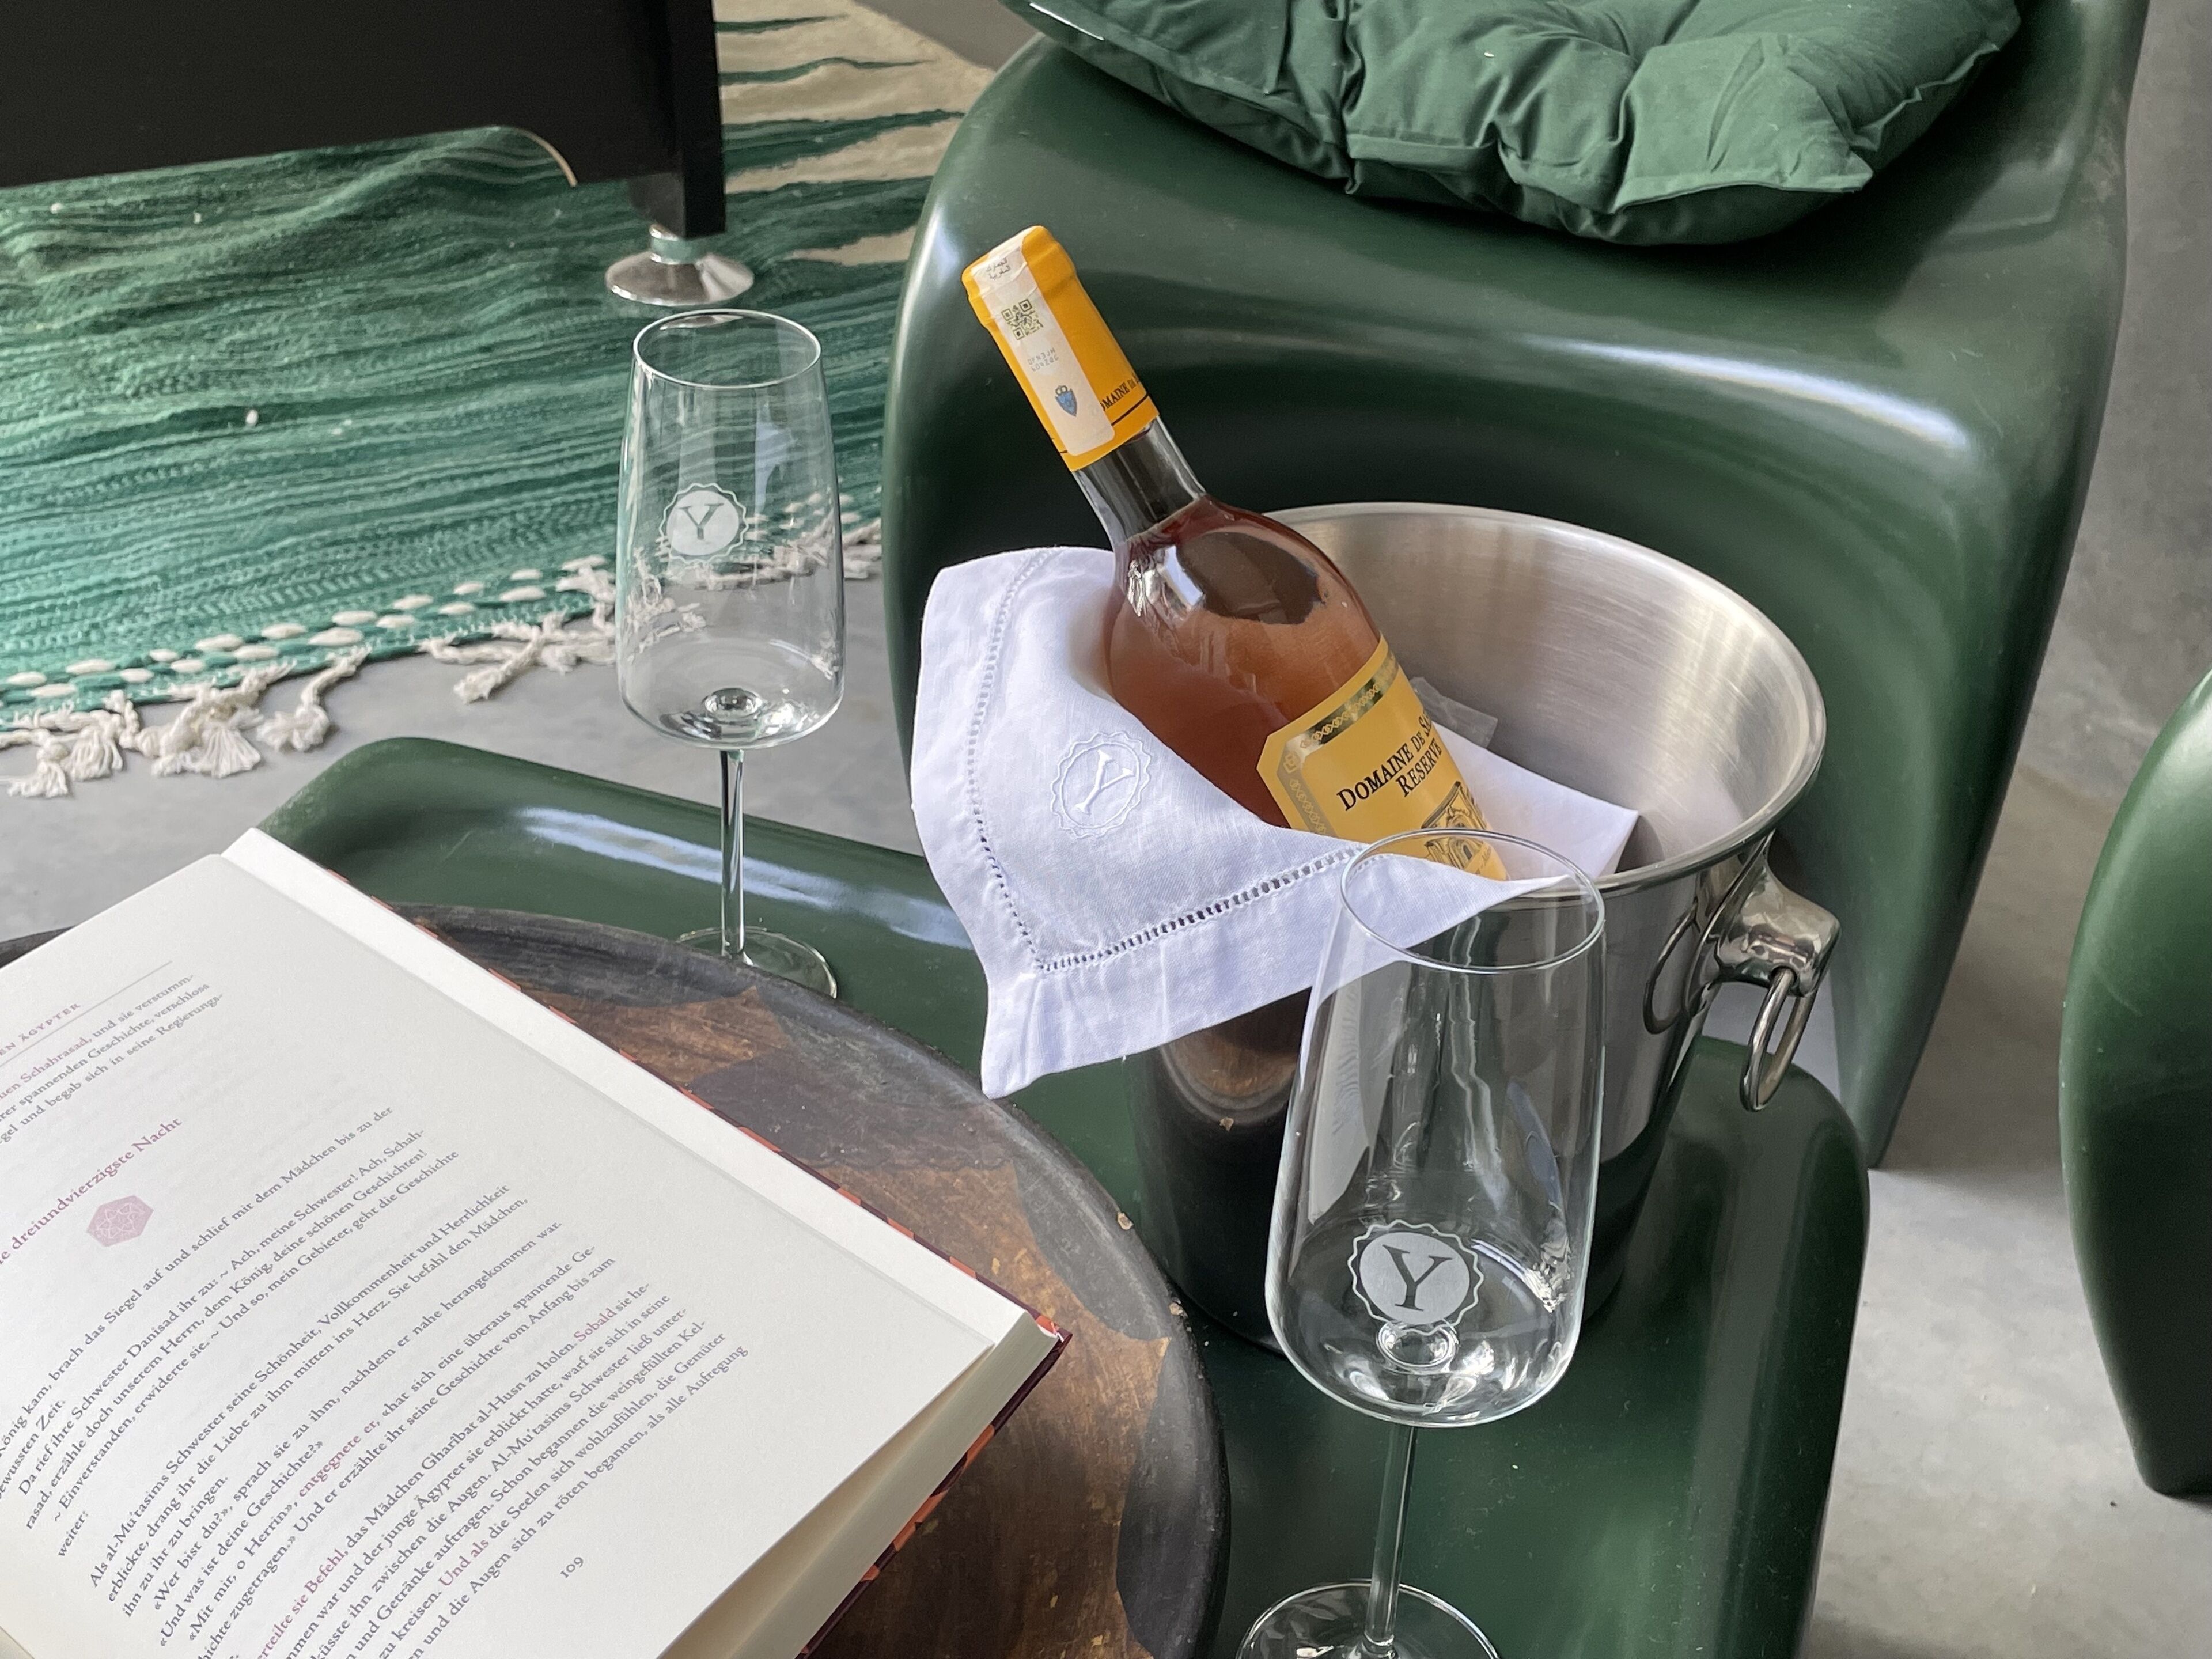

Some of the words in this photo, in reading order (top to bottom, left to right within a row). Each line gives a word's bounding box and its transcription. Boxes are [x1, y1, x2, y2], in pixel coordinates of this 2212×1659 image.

[677, 502, 724, 543] Y
[1075, 750, 1135, 814] Y
[1336, 744, 1413, 811] DOMAINE
[1414, 732, 1426, 752] DE
[1396, 738, 1442, 797] RESERVE
[12, 1152, 134, 1249] dreiundvierzigste
[131, 1119, 182, 1152] Nacht
[18, 1474, 37, 1495] Da
[36, 1444, 53, 1472] rief
[51, 1421, 74, 1448] ihre
[71, 1358, 128, 1420] Schwester
[127, 1310, 180, 1358] Danisad
[177, 1296, 197, 1312] ihr
[198, 1279, 218, 1296] zu:
[231, 1249, 260, 1270] Ach,
[259, 1220, 296, 1248] meine
[294, 1174, 358, 1221] Schwester!
[359, 1158, 386, 1176] Ach,
[22, 1385, 52, 1414] kam,
[48, 1348, 84, 1381] brach
[85, 1325, 105, 1344] das
[104, 1289, 142, 1324] Siegel
[143, 1268, 164, 1290] auf
[165, 1249, 191, 1271] und
[192, 1217, 230, 1251] schlief
[232, 1203, 254, 1220] mit
[255, 1184, 283, 1203] dem
[280, 1146, 337, 1184] Mädchen
[334, 1133, 355, 1145] bis
[357, 1122, 372, 1132] zu
[374, 1107, 392, 1121] der
[59, 1416, 135, 1509] Einverstanden,
[135, 1359, 189, 1414] erwiderte
[190, 1342, 210, 1359] sie.
[218, 1304, 250, 1328] Und
[250, 1293, 268, 1306] so,
[268, 1267, 300, 1291] mein
[298, 1228, 353, 1266] Gebieter,
[353, 1207, 378, 1230] geht
[378, 1195, 397, 1208] die
[396, 1152, 459, 1194] Geschichte
[1382, 1244, 1452, 1312] Y
[26, 1490, 52, 1529] rasad,
[51, 1440, 86, 1487] erzähle
[86, 1407, 113, 1438] doch
[113, 1357, 163, 1405] unserem
[160, 1320, 204, 1354] Herrn,
[204, 1295, 232, 1317] dem
[229, 1263, 273, 1294] König,
[274, 1237, 306, 1262] deine
[306, 1203, 354, 1237] schönen
[353, 1149, 427, 1200] Geschichten!
[109, 1541, 149, 1601] erblickte,
[147, 1498, 181, 1537] drang
[176, 1476, 196, 1497] ihr
[197, 1455, 216, 1474] die
[213, 1420, 249, 1453] Liebe
[250, 1404, 267, 1419] zu
[265, 1380, 294, 1402] ihm
[294, 1344, 335, 1378] mitten
[332, 1327, 354, 1343] ins
[351, 1301, 391, 1327] Herz.
[388, 1283, 411, 1299] Sie
[408, 1253, 448, 1283] befahl
[448, 1239, 471, 1255] den
[468, 1199, 528, 1238] Mädchen,
[177, 1542, 202, 1569] bist
[233, 1461, 271, 1502] sprach
[274, 1441, 291, 1458] sie
[292, 1424, 309, 1440] zu
[308, 1397, 340, 1422] ihm,
[341, 1349, 396, 1394] nachdem
[397, 1335, 411, 1347] er
[412, 1311, 442, 1335] nahe
[440, 1241, 536, 1310] herangekommen
[536, 1222, 562, 1238] war.
[36, 1401, 65, 1431] Zeit.
[214, 1575, 236, 1602] mir,
[237, 1560, 245, 1569] o
[299, 1436, 361, 1497] entgegnete
[364, 1421, 380, 1433] er,
[411, 1372, 436, 1392] sich
[438, 1349, 464, 1369] eine
[463, 1311, 511, 1347] überaus
[513, 1264, 572, 1310] spannende
[58, 1511, 88, 1556] weiter:
[123, 1593, 141, 1618] ihn
[139, 1573, 154, 1591] zu
[152, 1548, 168, 1571] ihr
[168, 1529, 183, 1547] zu
[179, 1477, 228, 1527] bringen.
[355, 1620, 380, 1651] und
[377, 1561, 434, 1620] Getränke
[434, 1504, 494, 1560] auftragen.
[491, 1467, 533, 1502] Schon
[528, 1419, 589, 1466] begannen
[588, 1402, 608, 1418] die
[607, 1342, 682, 1400] weingefüllten
[391, 1592, 442, 1641] kreisen.
[438, 1556, 471, 1586] Und
[471, 1540, 488, 1558] als
[488, 1520, 509, 1539] die
[507, 1483, 551, 1519] Seelen
[550, 1460, 575, 1482] sich
[575, 1393, 657, 1457] wohlzufühlen,
[656, 1375, 676, 1390] die
[674, 1334, 725, 1373] Gemüter
[423, 1615, 450, 1645] und
[449, 1595, 470, 1615] die
[470, 1554, 511, 1594] Augen
[511, 1528, 536, 1552] sich
[537, 1511, 555, 1527] zu
[555, 1481, 588, 1510] röten
[584, 1431, 648, 1479] begannen,
[647, 1414, 665, 1429] als
[665, 1396, 687, 1414] alle
[686, 1346, 748, 1396] Aufregung
[184, 1577, 204, 1603] was
[201, 1557, 219, 1576] ist
[218, 1520, 248, 1555] deine
[560, 1557, 584, 1578] 109
